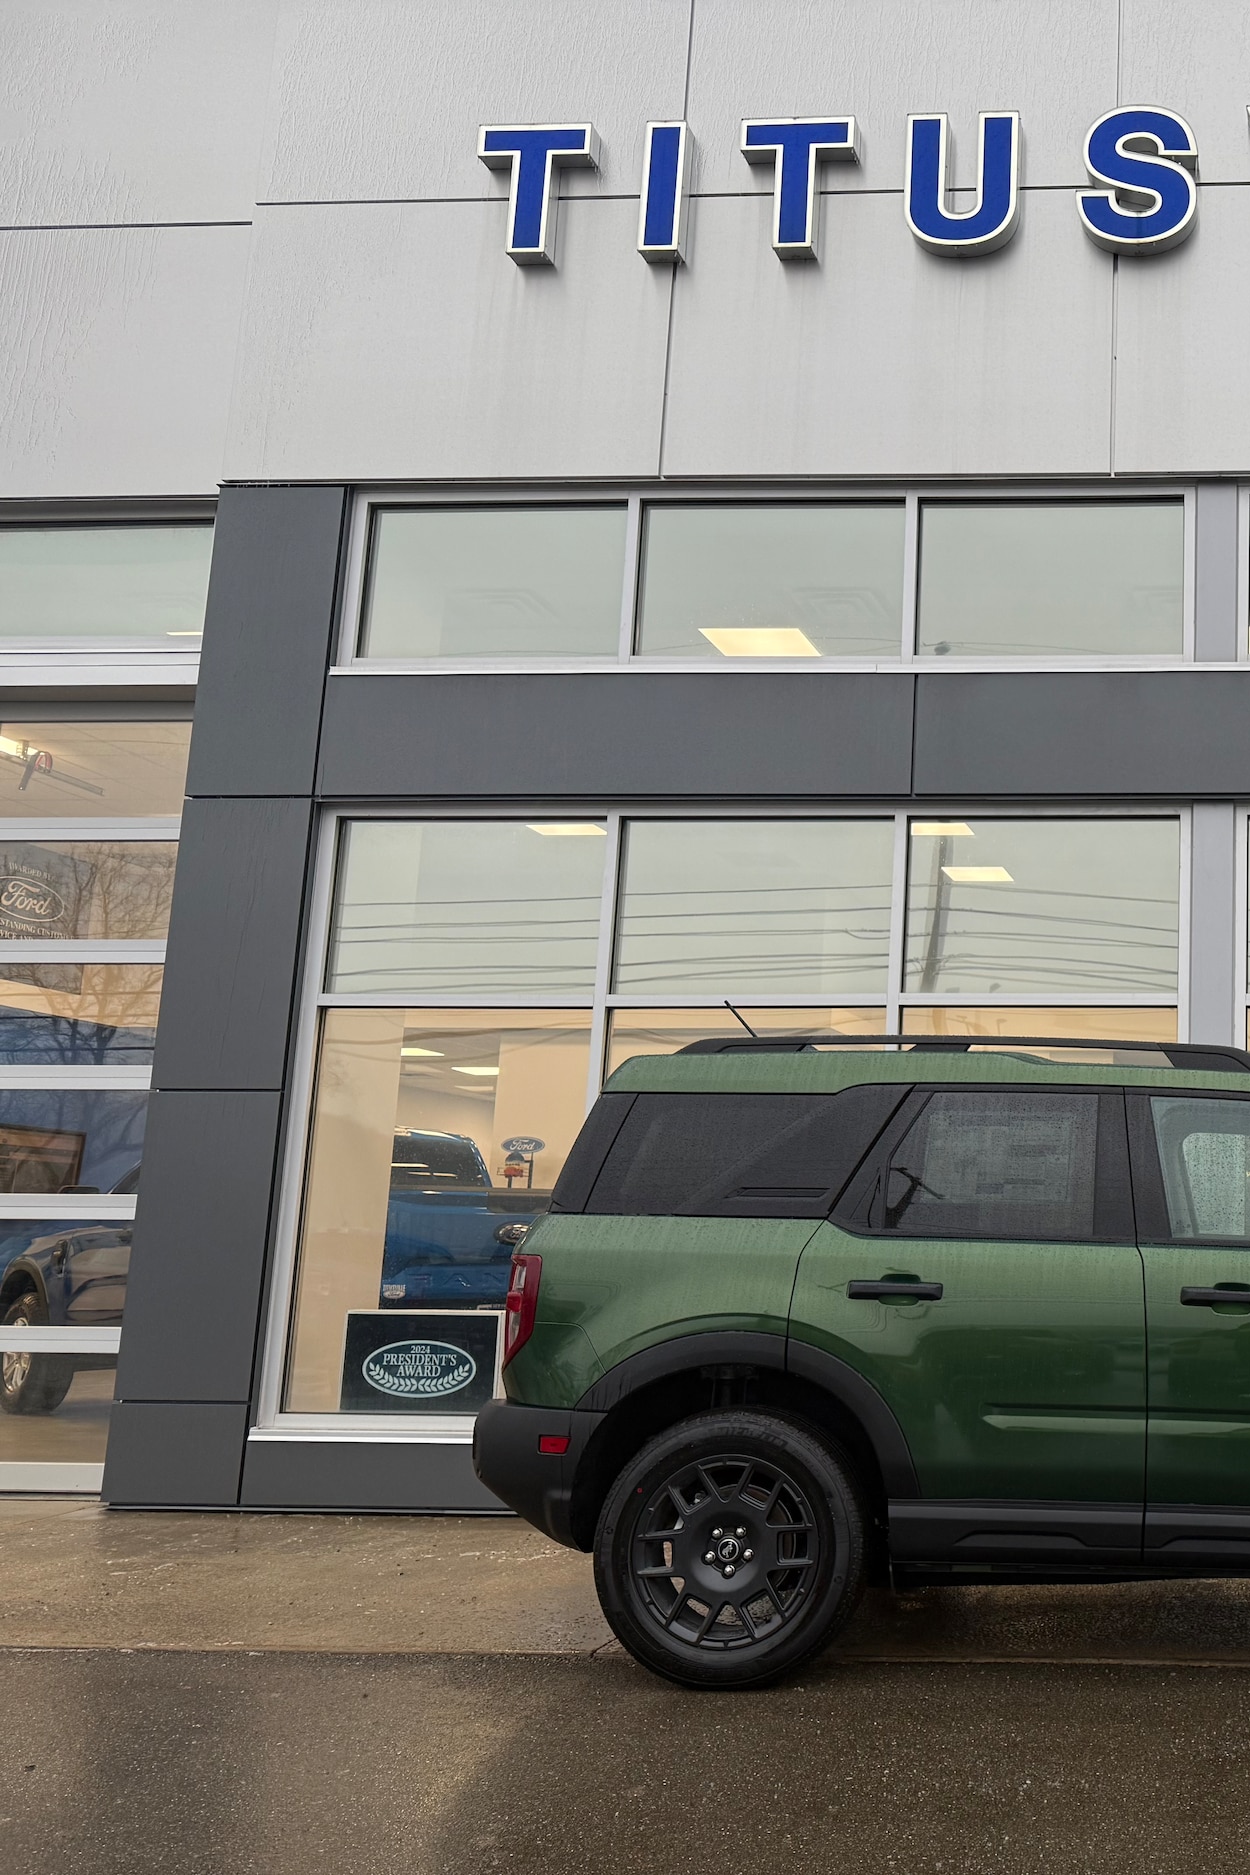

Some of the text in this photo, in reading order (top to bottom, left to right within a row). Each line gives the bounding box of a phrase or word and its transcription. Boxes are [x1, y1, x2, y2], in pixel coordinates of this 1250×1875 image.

[1, 881, 51, 915] Ford
[510, 1139, 536, 1151] Ford
[410, 1345, 431, 1354] 2024
[382, 1353, 457, 1366] PRESIDENT'S
[396, 1365, 441, 1377] AWARD
